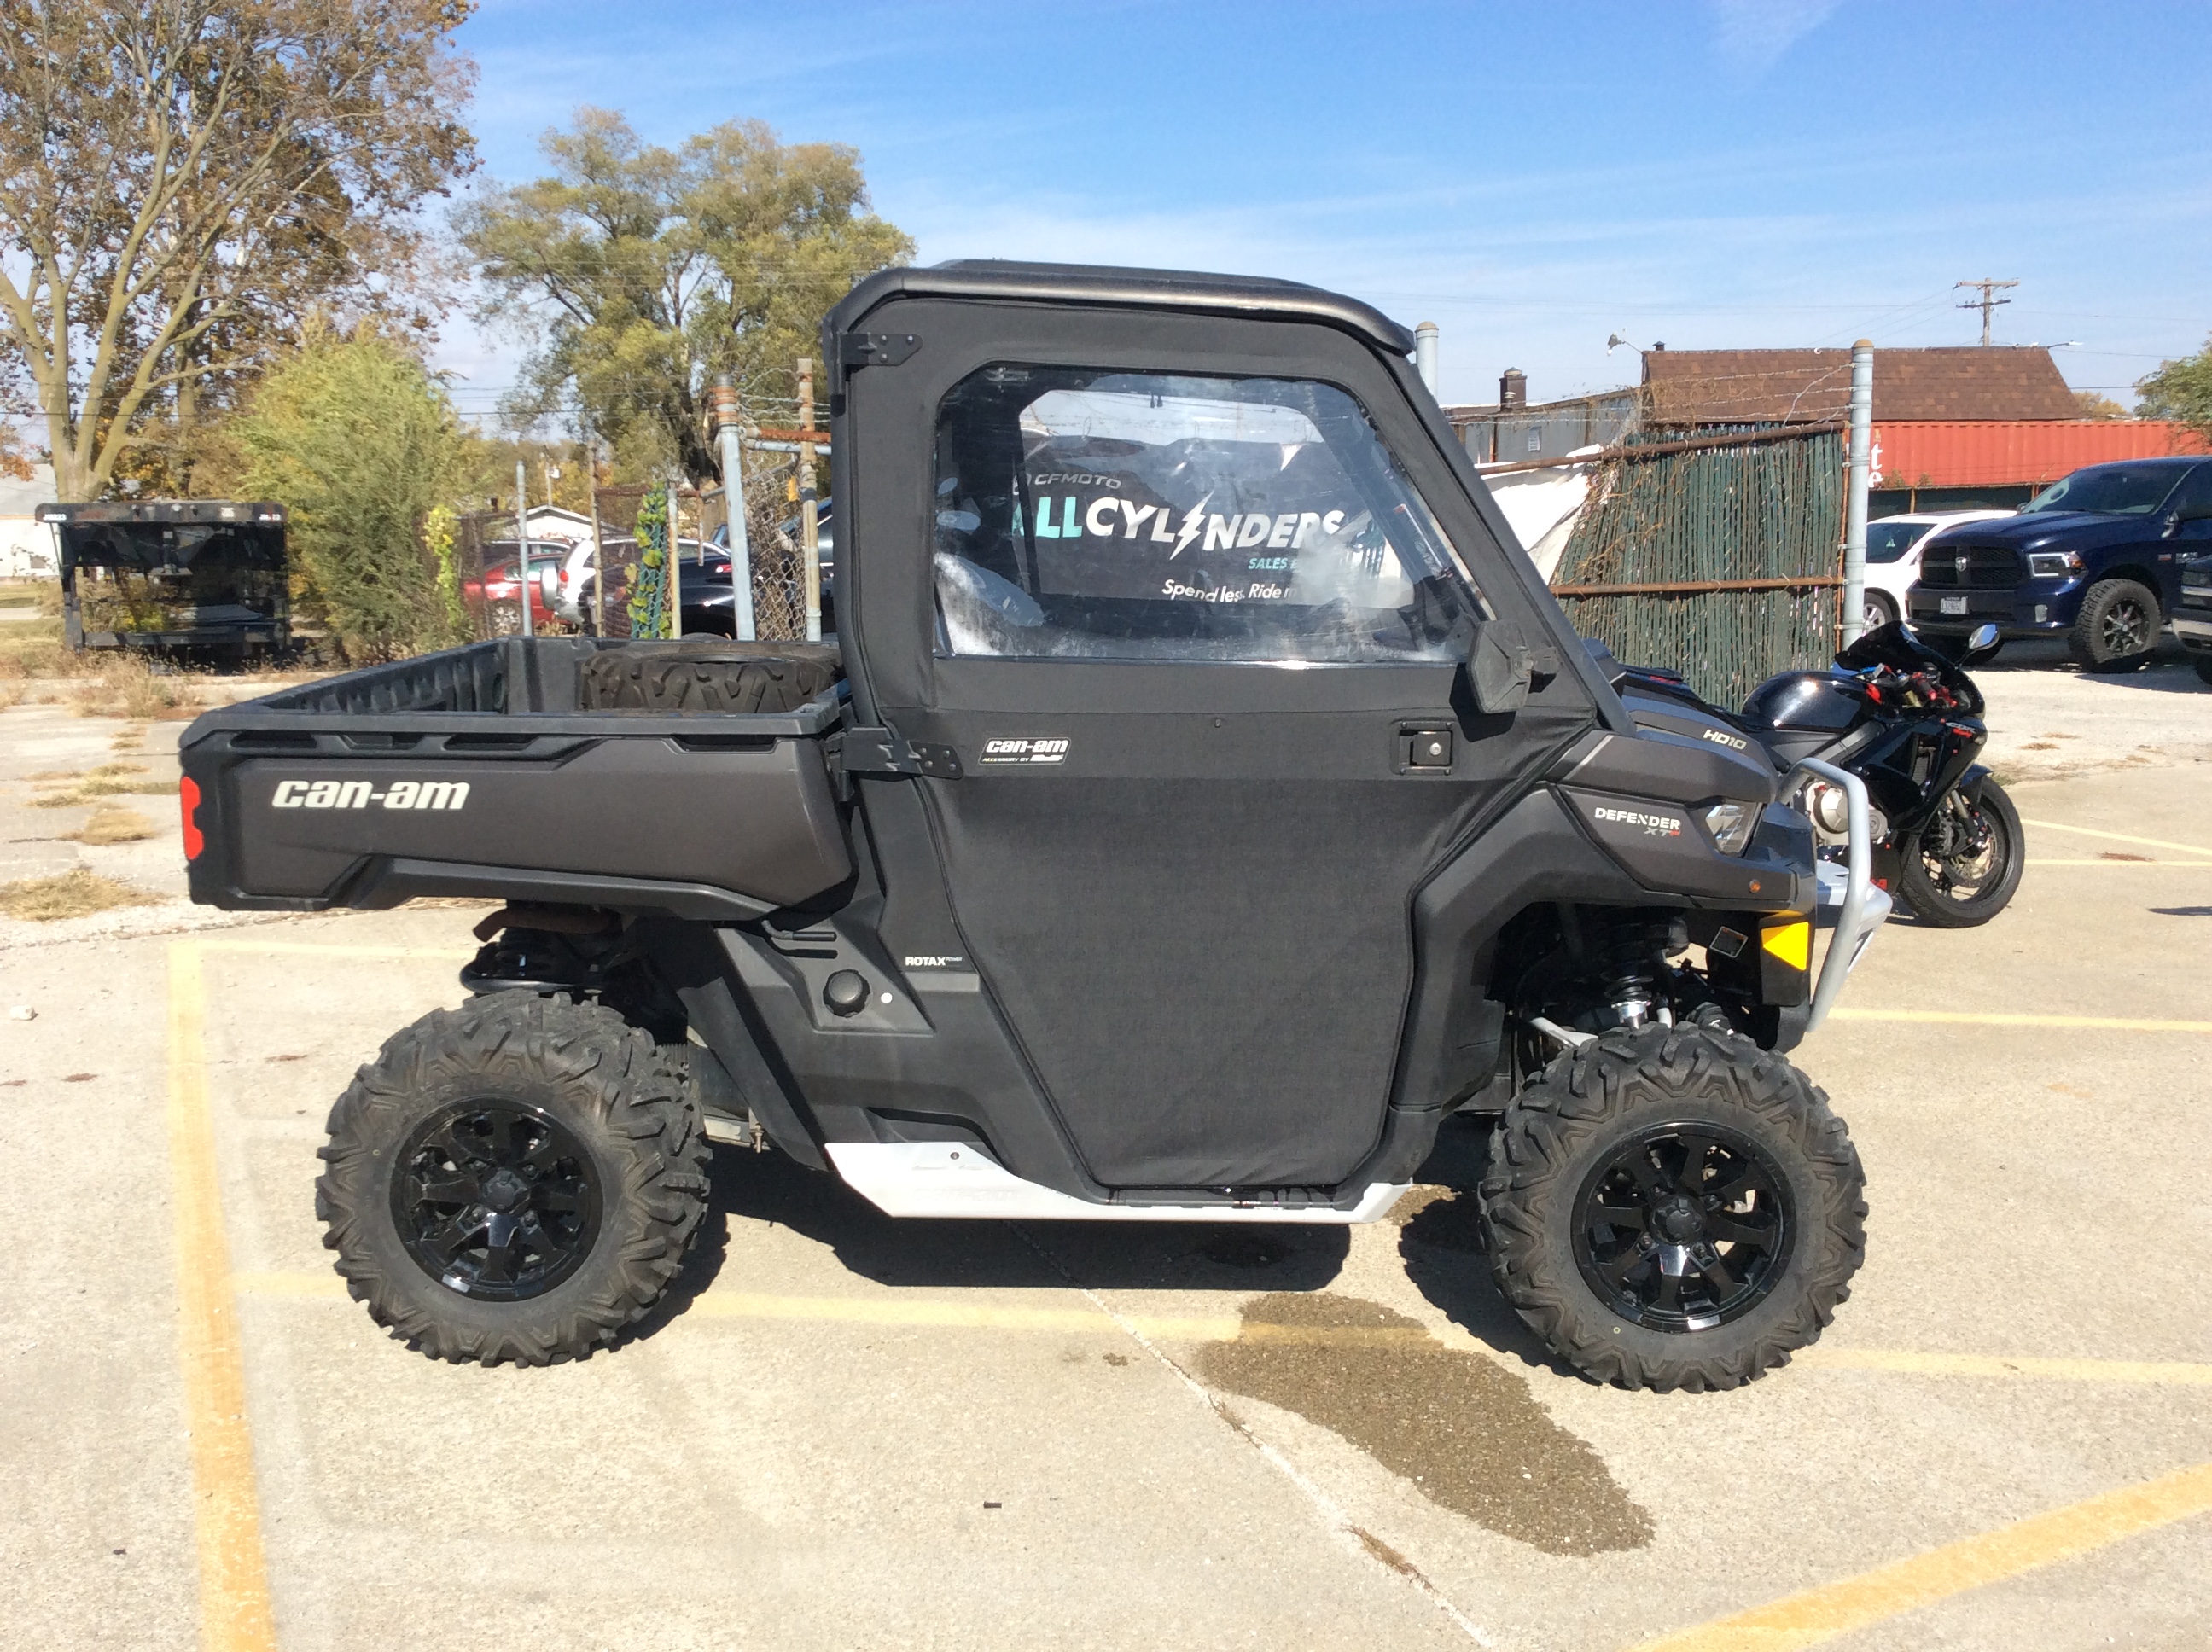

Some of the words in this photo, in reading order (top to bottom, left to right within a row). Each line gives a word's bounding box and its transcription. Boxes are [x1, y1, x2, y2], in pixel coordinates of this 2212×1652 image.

[1034, 473, 1122, 490] CFMOTO
[1248, 557, 1289, 570] SALES
[1161, 579, 1220, 602] Spend
[1248, 583, 1281, 599] Ride
[986, 740, 1068, 753] can-am
[1703, 729, 1747, 750] HD10
[271, 780, 470, 810] can-am
[1594, 806, 1681, 830] DEFENDER
[905, 956, 946, 966] ROTAX
